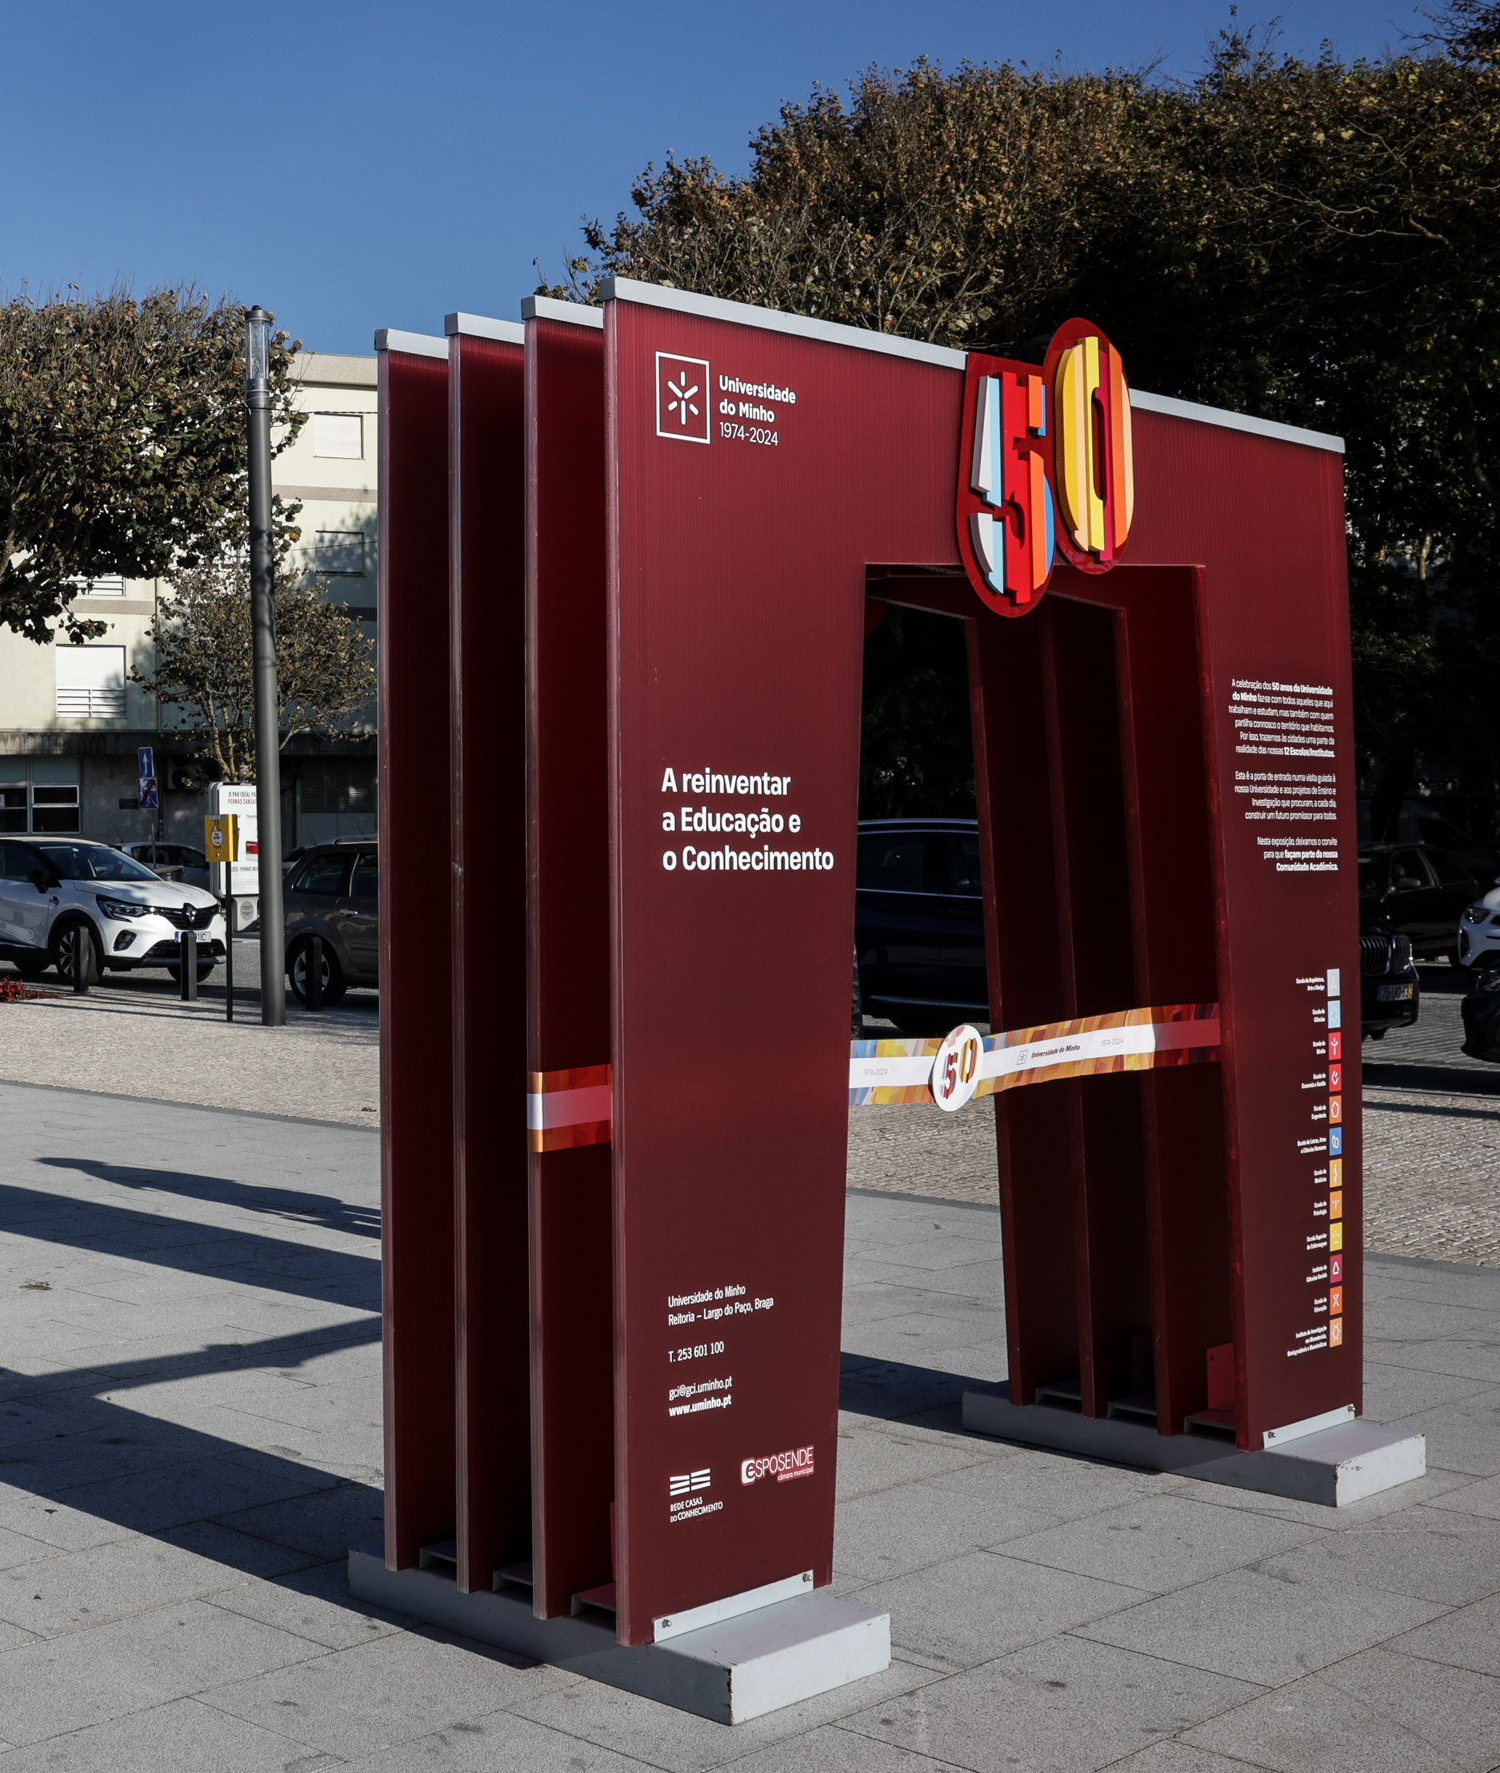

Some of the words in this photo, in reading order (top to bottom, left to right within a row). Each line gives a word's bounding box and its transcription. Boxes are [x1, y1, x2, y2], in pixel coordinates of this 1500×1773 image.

[719, 375, 797, 404] Universidade
[719, 399, 736, 415] do
[739, 403, 775, 422] Minho
[720, 421, 779, 446] 1974-2024
[970, 336, 1134, 604] 50
[1236, 680, 1262, 690] celebração
[1263, 682, 1271, 690] dos
[1301, 685, 1333, 695] Universidade
[1241, 693, 1257, 701] Minho
[1258, 694, 1270, 703] faz-se
[1296, 698, 1313, 707] aqueles
[1324, 700, 1333, 708] aqui
[1236, 745, 1257, 754] realidade
[1258, 746, 1267, 754] das
[1290, 747, 1335, 757] Escolas/Institutos.
[661, 768, 678, 792] A
[682, 768, 791, 795] reinventar
[662, 811, 676, 831] a
[681, 806, 784, 838] Educação
[789, 814, 801, 833] e
[663, 851, 677, 870] o
[682, 845, 834, 870] Conhecimento
[1275, 851, 1284, 859] que
[1285, 850, 1301, 860] façam
[1302, 851, 1314, 859] parte
[1277, 863, 1309, 871] Comunidade
[1031, 1047, 1058, 1058] Universidade
[1065, 1044, 1081, 1052] Minho
[940, 1037, 978, 1100] 50
[668, 1290, 713, 1308] Universidade
[715, 1289, 723, 1299] do
[725, 1284, 745, 1297] Minho
[668, 1312, 695, 1326] Reitoria
[703, 1308, 723, 1320] Largo
[724, 1305, 733, 1316] do
[734, 1302, 753, 1315] Paço,
[754, 1297, 774, 1310] Braga
[668, 1351, 676, 1363] T.
[677, 1347, 692, 1361] 253
[694, 1344, 708, 1358] 601
[711, 1341, 724, 1354] 100
[669, 1376, 732, 1401] gci@gci.uminho.pt
[669, 1395, 731, 1417] www.uminho.pt
[778, 1471, 792, 1481] câmara
[794, 1466, 813, 1478] municipal
[670, 1501, 684, 1512] REDE
[685, 1497, 703, 1508] CASAS
[670, 1514, 677, 1522] DO
[677, 1501, 723, 1521] CONHECIMENTO
